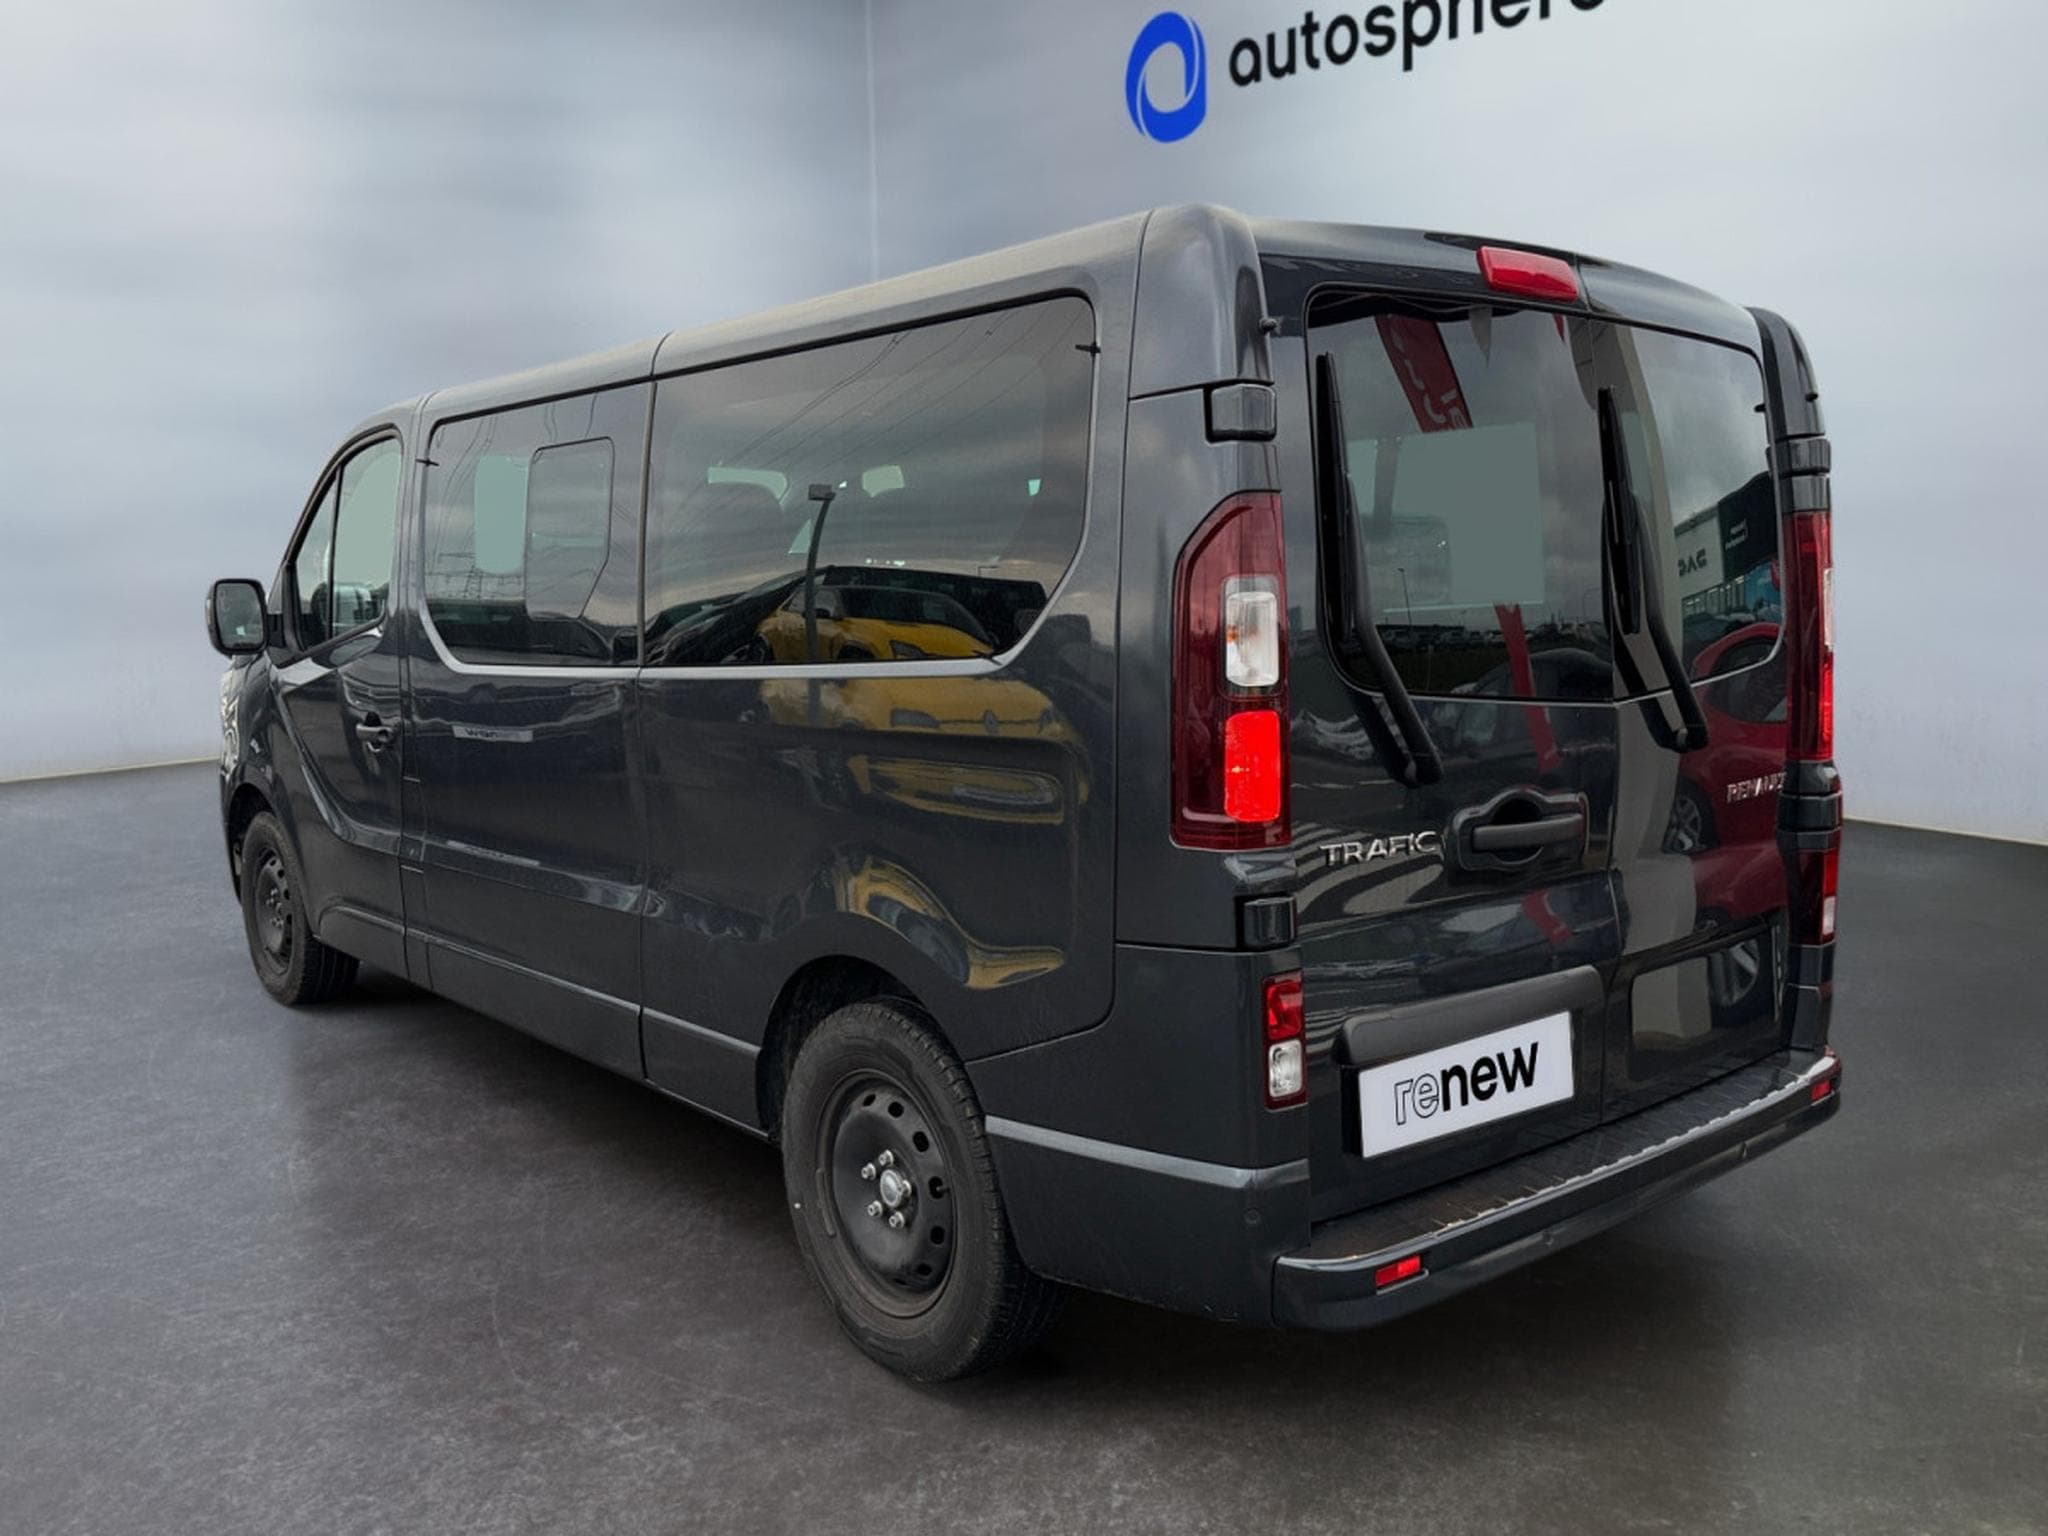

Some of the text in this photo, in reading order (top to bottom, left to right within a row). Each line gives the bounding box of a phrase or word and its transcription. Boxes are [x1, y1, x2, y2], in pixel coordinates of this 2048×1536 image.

[1229, 0, 1606, 86] autosphe
[1319, 830, 1437, 866] TRAFIC
[1394, 1041, 1539, 1126] renew
